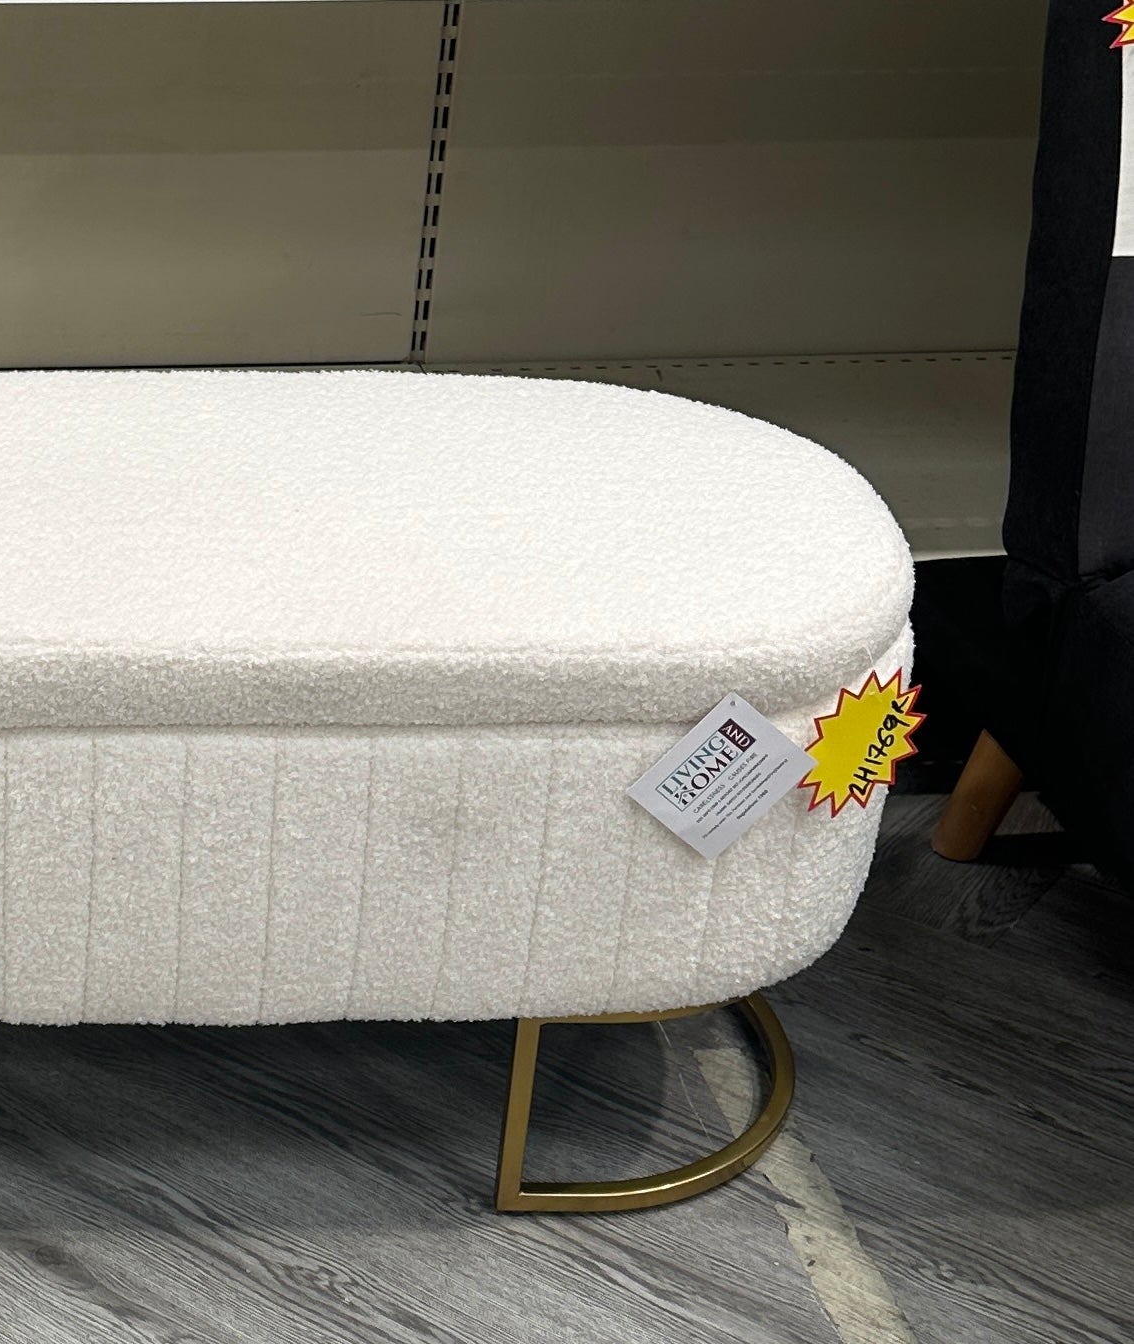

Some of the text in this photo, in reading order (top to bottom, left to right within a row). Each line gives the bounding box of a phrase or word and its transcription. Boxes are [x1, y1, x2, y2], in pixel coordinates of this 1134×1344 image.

[661, 735, 726, 796] LIVING
[721, 723, 752, 748] AND
[673, 744, 739, 806] HOME
